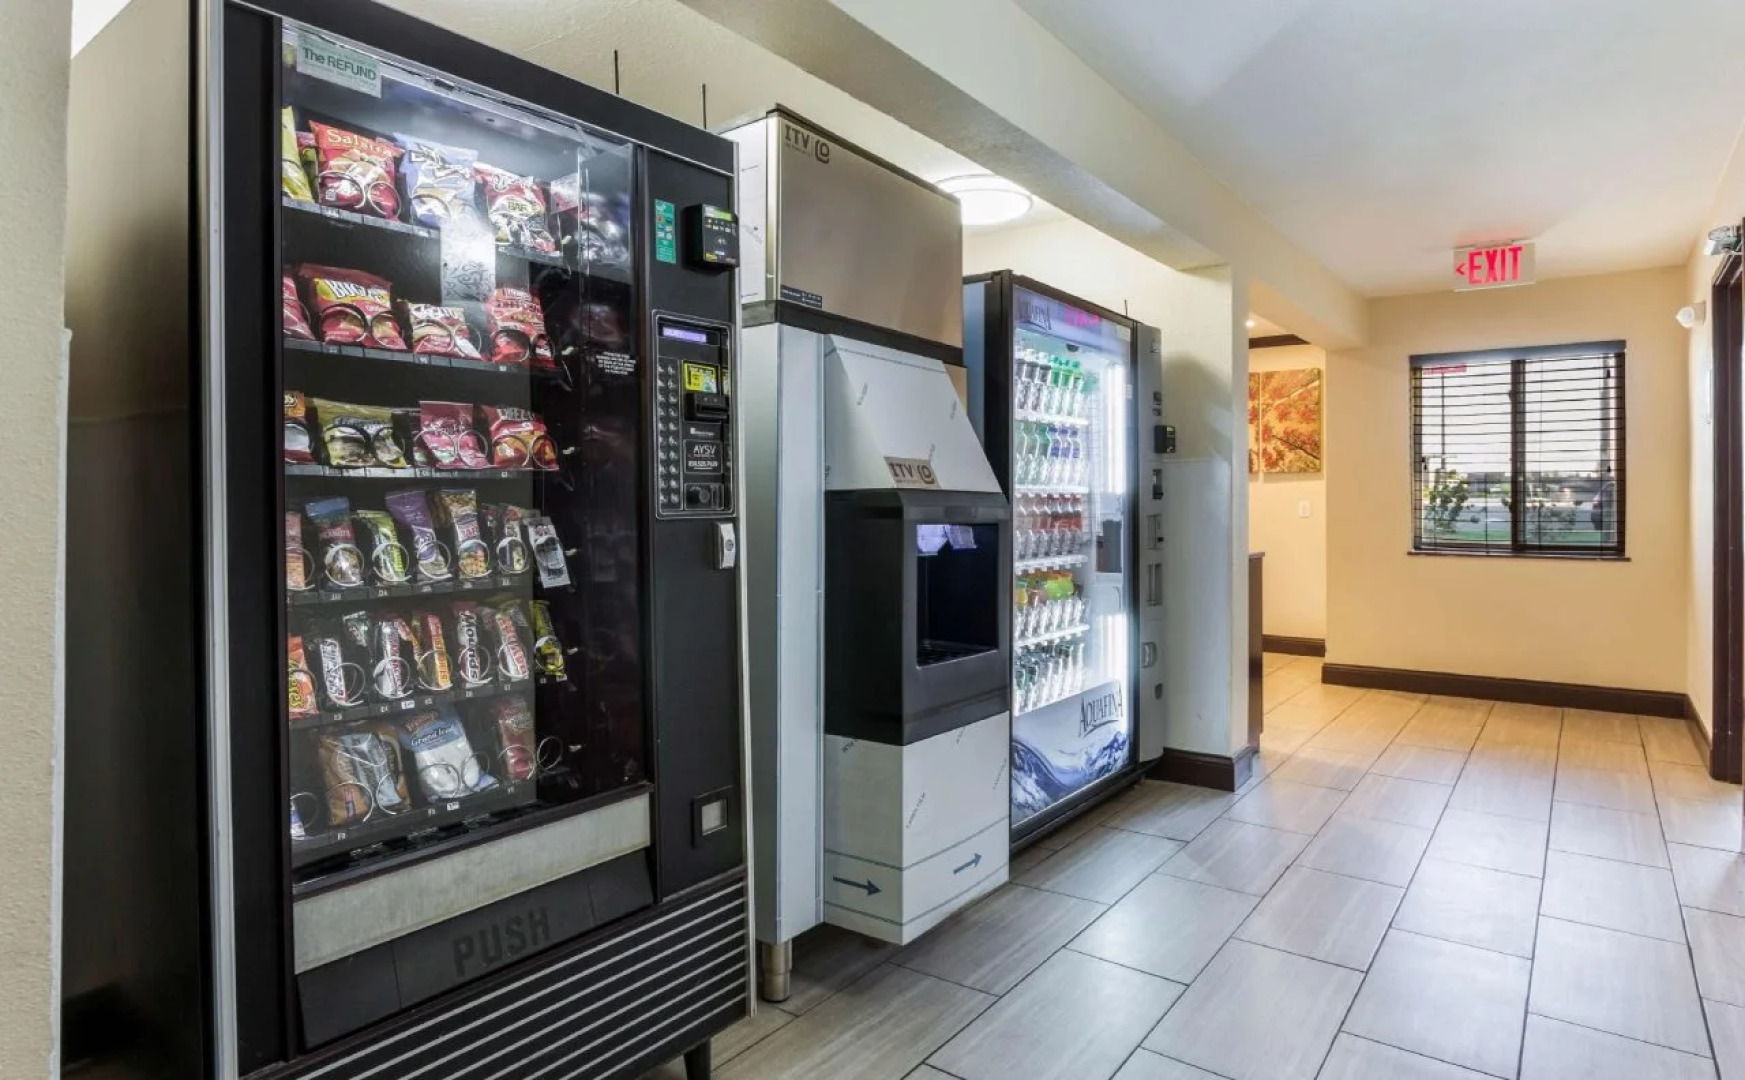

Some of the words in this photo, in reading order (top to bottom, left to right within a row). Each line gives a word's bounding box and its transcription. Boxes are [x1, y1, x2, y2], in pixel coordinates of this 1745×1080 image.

[303, 46, 325, 64] The
[327, 55, 377, 81] REFUND
[784, 123, 811, 149] ITV
[1467, 245, 1523, 285] EXIT
[888, 462, 913, 478] ITV
[1078, 682, 1123, 738] AQUAFINA
[453, 906, 550, 977] PUSH
